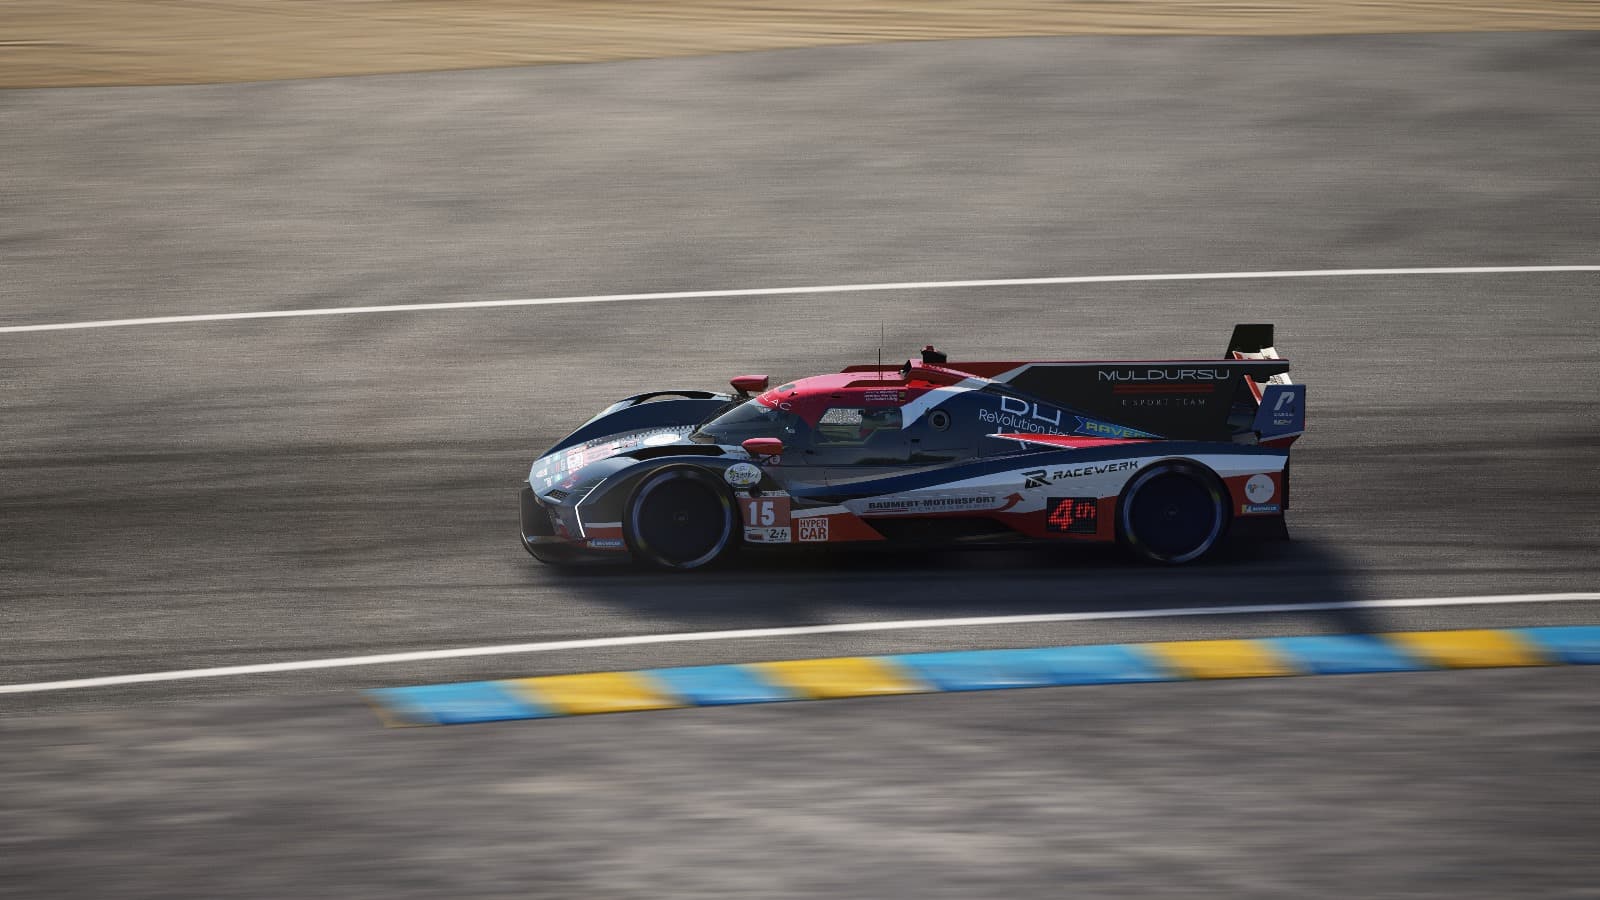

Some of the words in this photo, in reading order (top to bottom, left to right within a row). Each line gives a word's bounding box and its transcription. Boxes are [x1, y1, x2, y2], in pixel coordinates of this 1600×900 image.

[1099, 369, 1230, 381] MULDURSU
[979, 408, 1045, 434] ReVolution
[1053, 461, 1138, 480] RACEWERK
[748, 501, 775, 526] 15
[1048, 499, 1096, 530] 4th
[800, 520, 827, 528] HYPER
[800, 528, 827, 540] CAR
